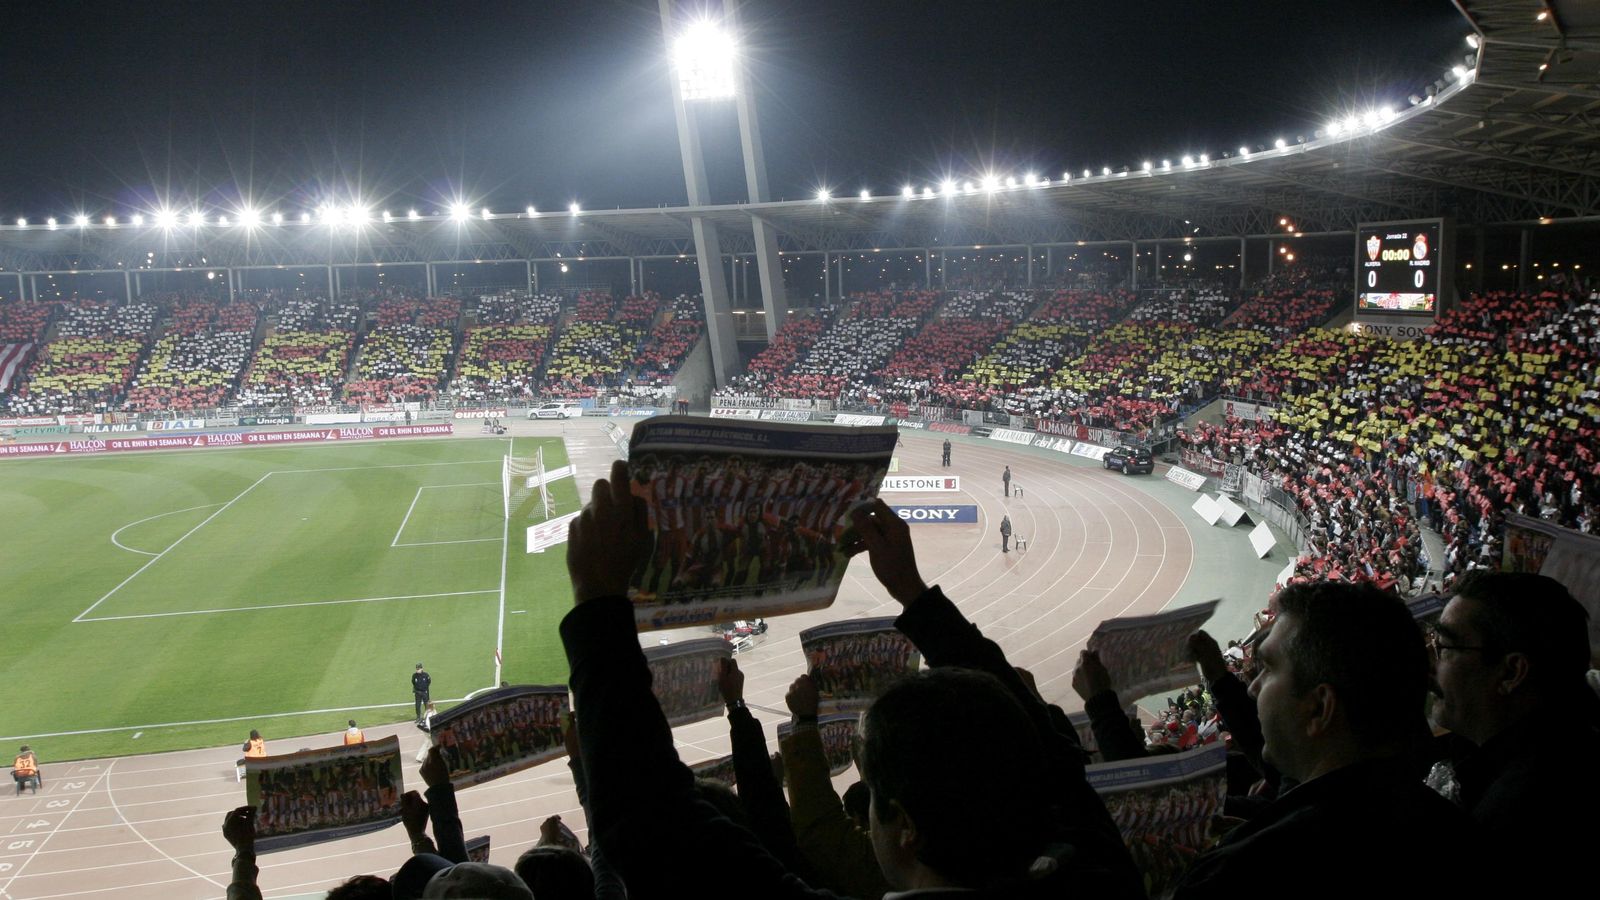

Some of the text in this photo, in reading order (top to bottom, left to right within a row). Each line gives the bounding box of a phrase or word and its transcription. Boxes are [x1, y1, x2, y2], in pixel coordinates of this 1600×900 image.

[1382, 249, 1410, 261] 00:00
[1368, 270, 1376, 288] 0
[1414, 270, 1424, 288] 0
[454, 410, 506, 419] eurotex
[153, 420, 199, 430] DIAL
[256, 417, 290, 426] Unicaja
[898, 419, 924, 430] Unicaja
[340, 427, 374, 437] HALCON
[422, 425, 448, 434] SEMANA
[208, 433, 242, 443] HALCON
[293, 432, 320, 440] SEMANA
[20, 444, 48, 453] SEMANA
[70, 440, 106, 450] HALCON
[898, 508, 960, 520] SONY
[21, 760, 31, 769] 32
